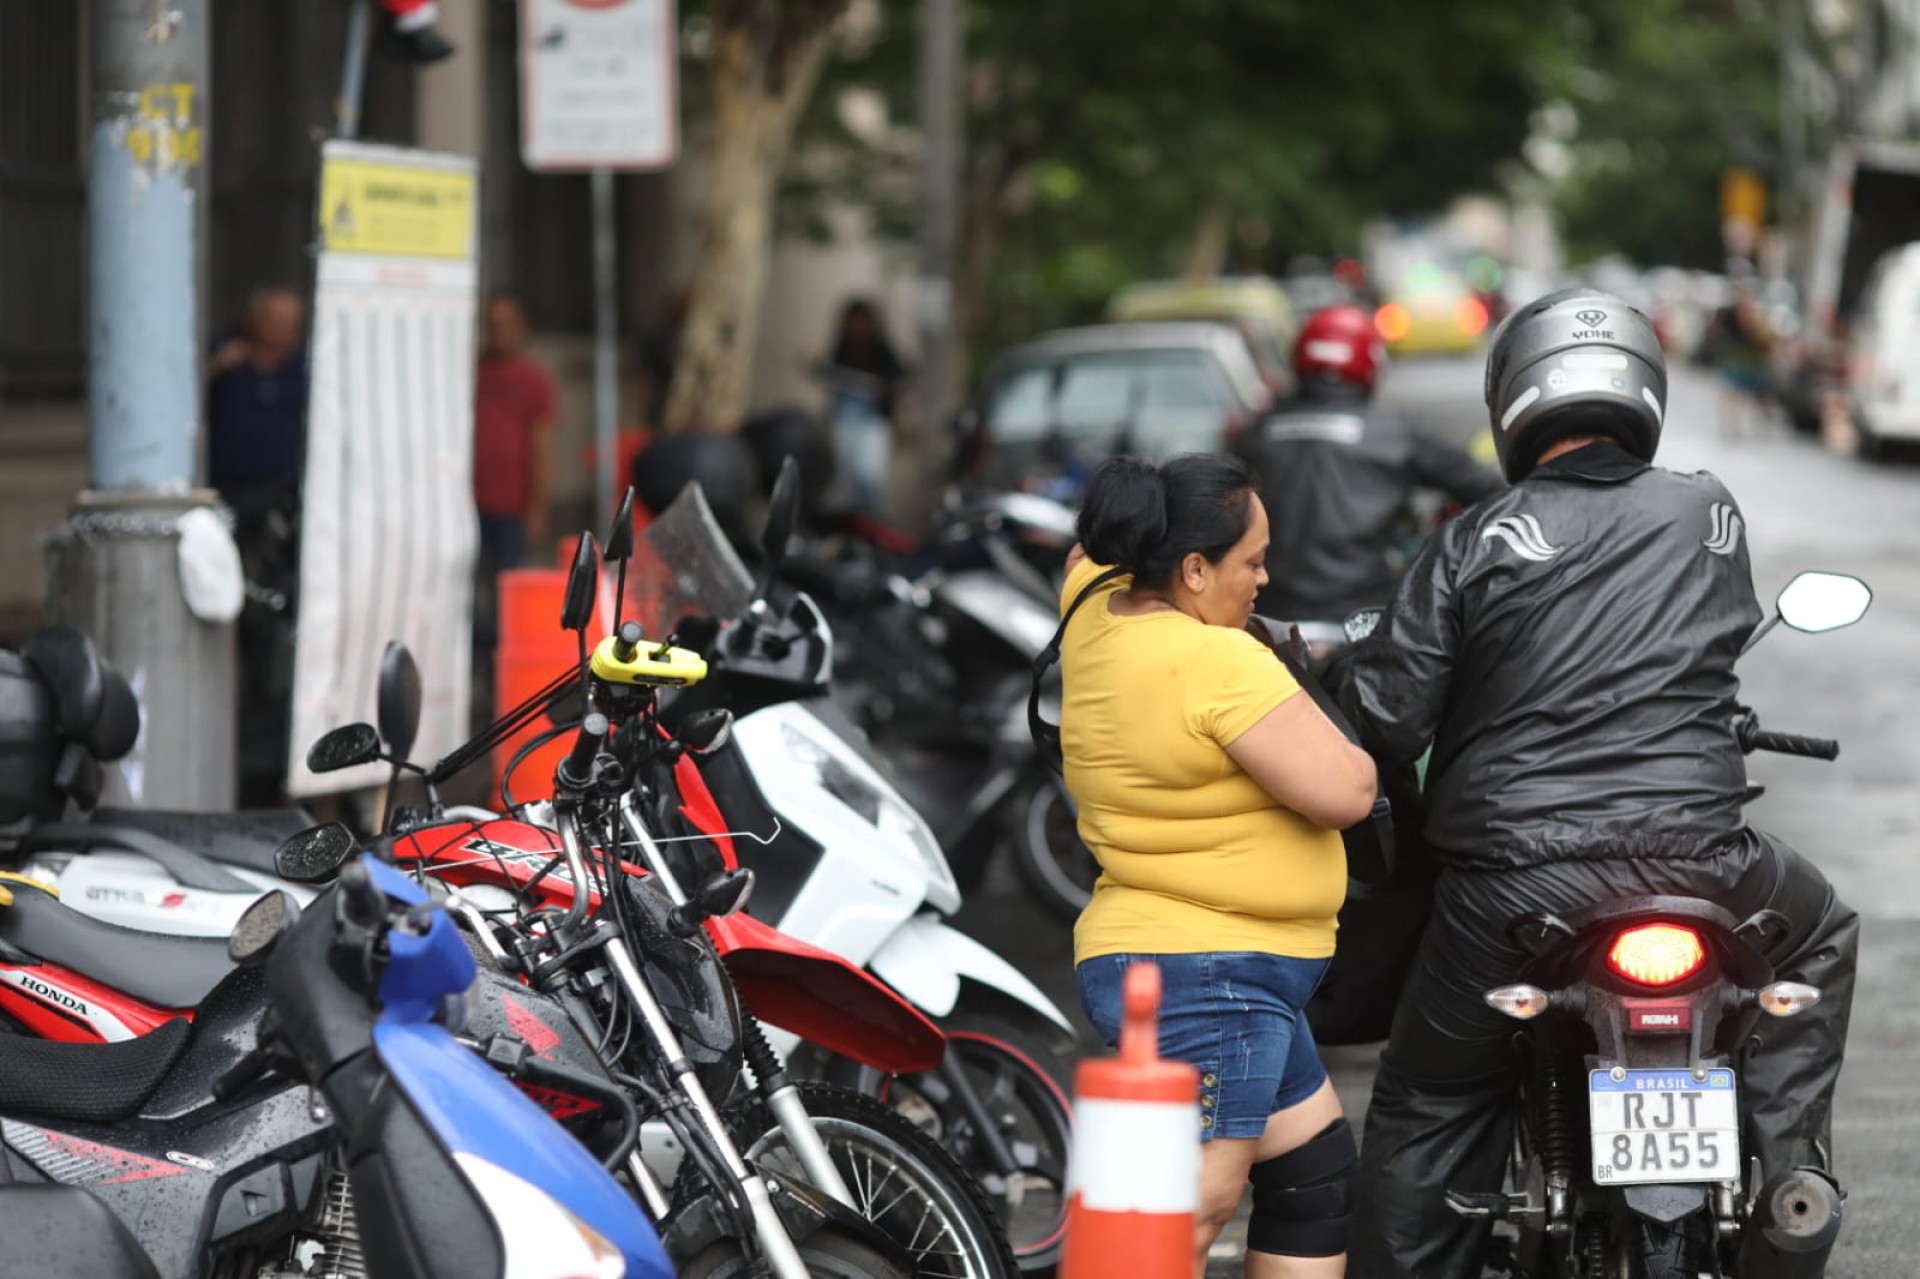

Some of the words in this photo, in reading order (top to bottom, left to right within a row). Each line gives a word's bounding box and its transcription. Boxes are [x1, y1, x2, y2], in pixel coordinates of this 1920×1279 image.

[1572, 330, 1615, 340] YOHE
[21, 976, 88, 1016] HONDA
[1636, 1077, 1689, 1090] BRASIL
[1623, 1092, 1702, 1129] RJT
[1612, 1132, 1719, 1171] 8A55
[1597, 1165, 1613, 1179] BR
